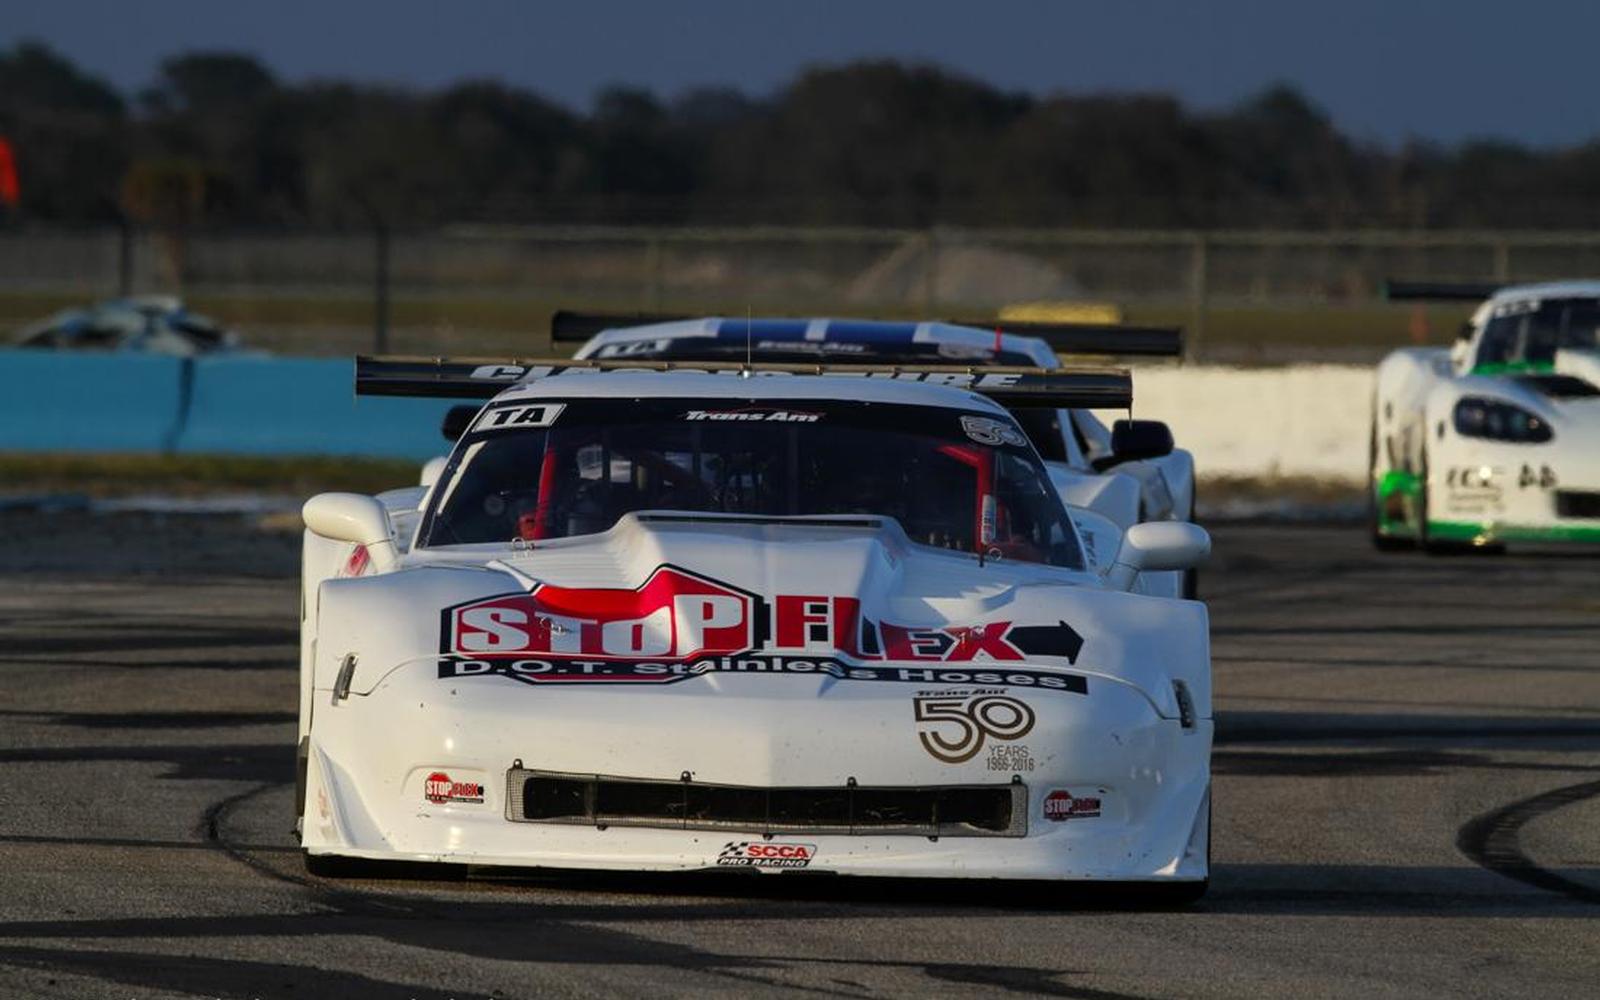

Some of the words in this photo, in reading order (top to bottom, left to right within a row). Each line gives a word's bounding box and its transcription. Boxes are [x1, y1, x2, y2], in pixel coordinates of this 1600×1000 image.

[493, 407, 546, 426] TA
[686, 410, 765, 420] Trans
[766, 412, 819, 422] Am
[460, 594, 743, 656] STOP
[775, 595, 1026, 662] FLEX
[455, 660, 613, 675] D.O.T.
[635, 656, 878, 679] Stainless
[899, 668, 1068, 689] Hoses
[913, 696, 1036, 764] 50
[989, 745, 1030, 758] YEARS
[426, 780, 452, 796] STOP
[1046, 798, 1072, 814] STOP
[747, 845, 809, 858] SCCA
[719, 857, 749, 866] PRO
[752, 858, 806, 868] RACING
